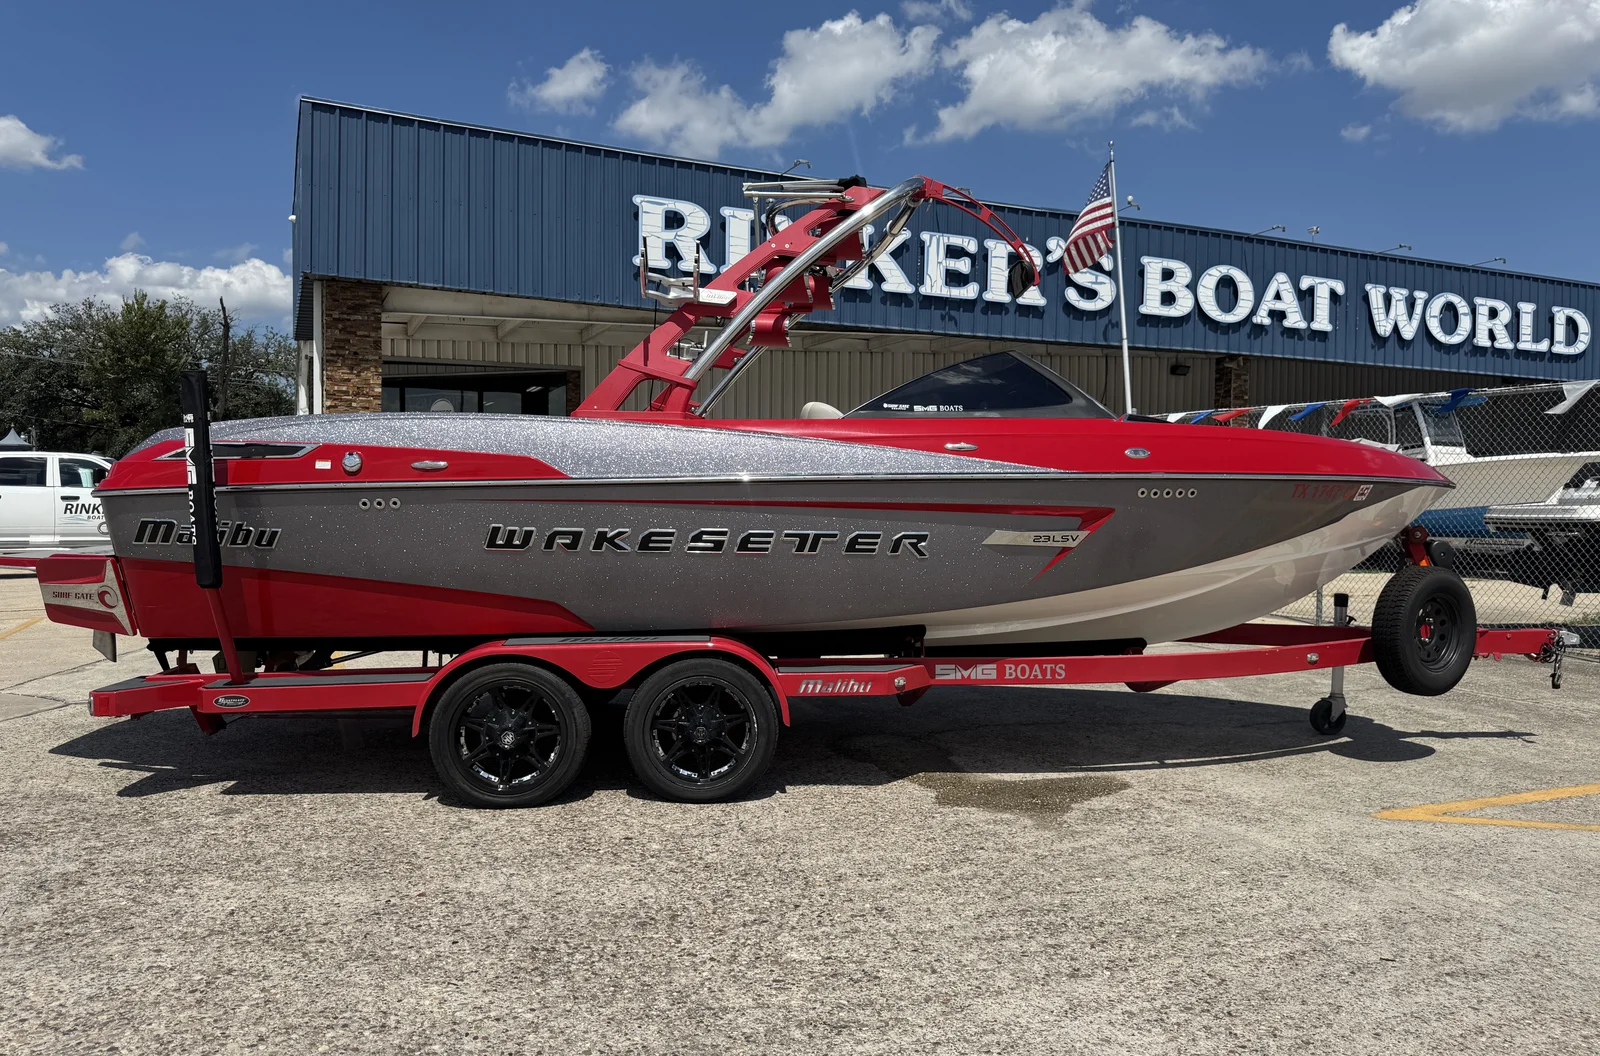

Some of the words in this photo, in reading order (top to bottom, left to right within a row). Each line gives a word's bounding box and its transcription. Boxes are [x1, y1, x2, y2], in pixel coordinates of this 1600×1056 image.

[632, 194, 1117, 311] RIKER'S
[1138, 255, 1346, 332] BOAT
[1364, 283, 1591, 355] WORLD
[939, 404, 964, 412] BOATS
[1291, 483, 1310, 499] TX
[63, 503, 104, 515] RINK
[132, 518, 282, 549] Maibu
[483, 523, 930, 559] WAKESETTER
[1032, 534, 1080, 543] 23LSV
[52, 591, 73, 599] SURF
[74, 592, 95, 600] GATE
[935, 664, 997, 680] SMG
[1003, 663, 1066, 680] BOATS
[799, 678, 873, 693] Malibu
